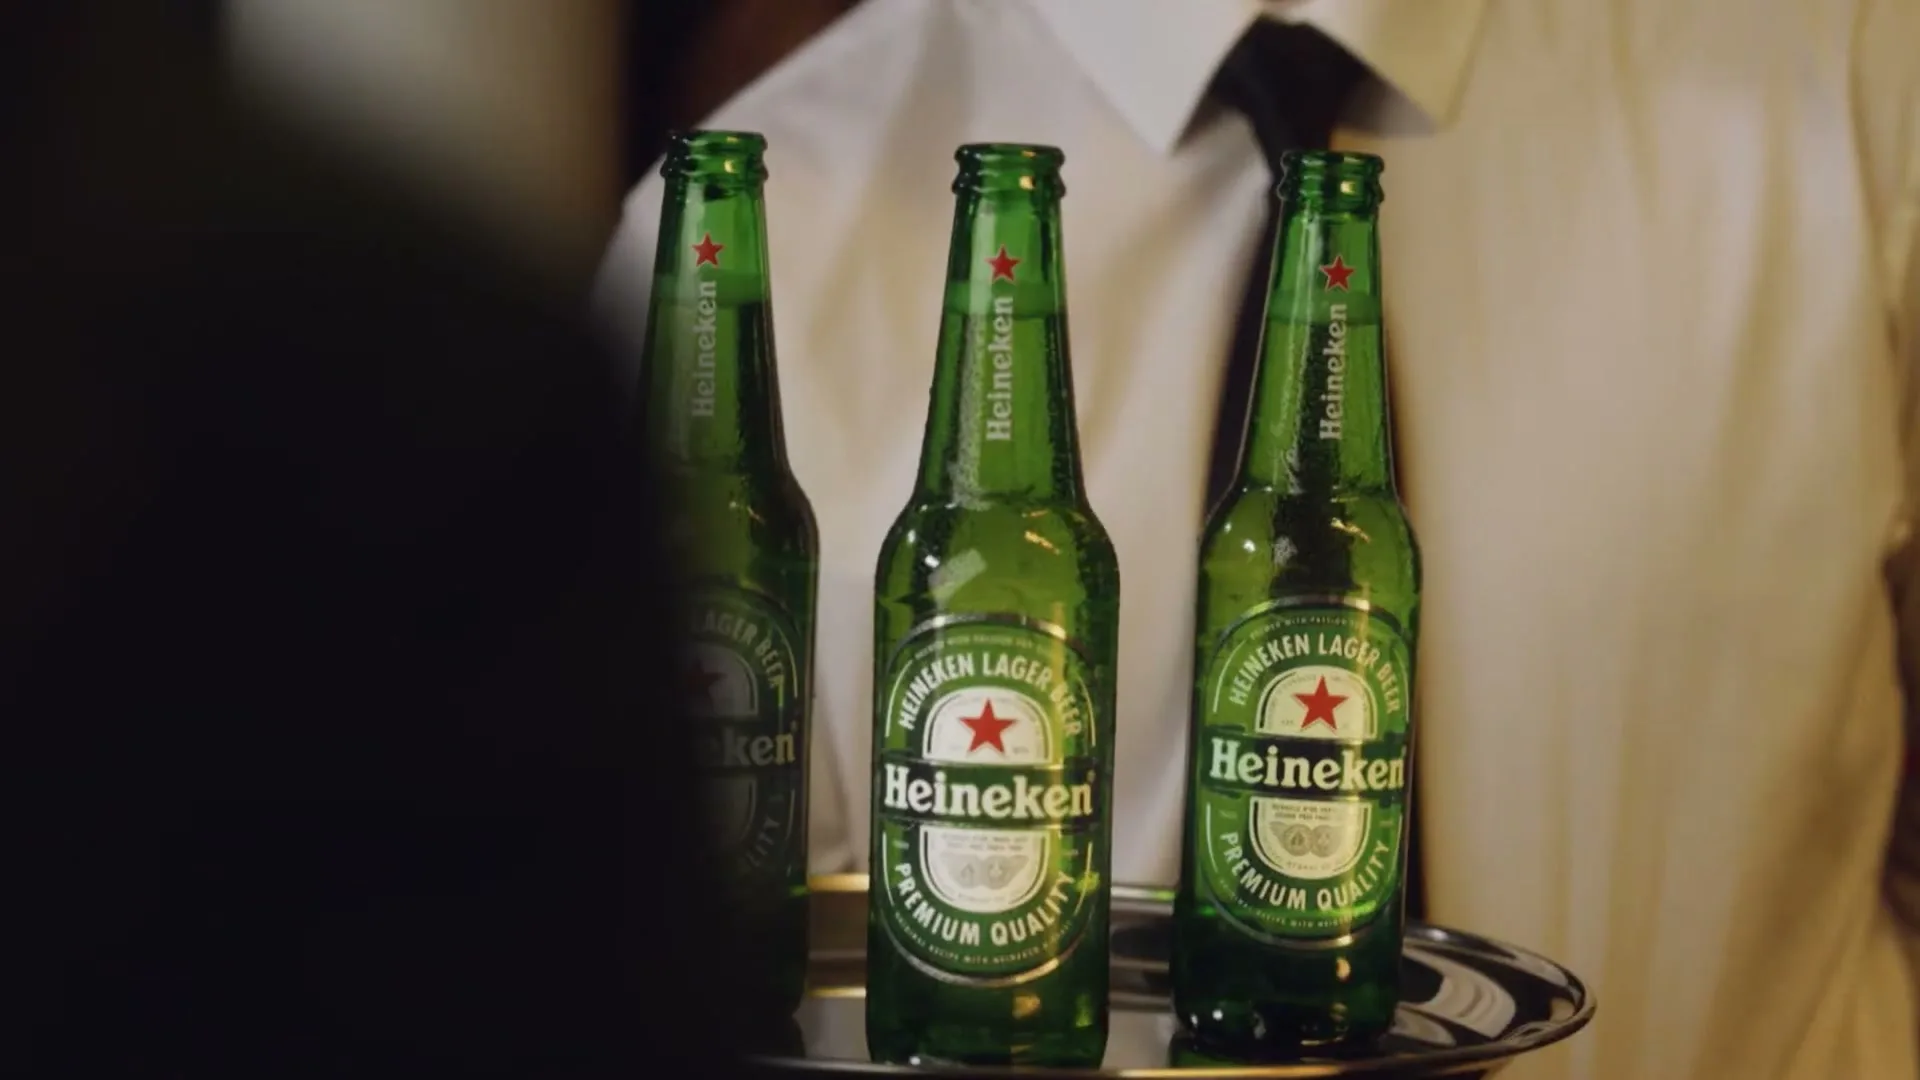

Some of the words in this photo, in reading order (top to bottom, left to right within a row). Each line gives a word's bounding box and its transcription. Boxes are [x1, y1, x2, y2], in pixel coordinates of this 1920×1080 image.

[692, 280, 716, 416] Heineken
[986, 296, 1013, 440] Heineken
[1319, 303, 1347, 440] Heineken
[898, 652, 974, 731] HEINEKEN
[983, 652, 1054, 690] LAGER
[1050, 683, 1082, 737] BEER
[1229, 633, 1311, 706] HEINEKEN
[1318, 633, 1379, 669] LAGER
[1377, 662, 1400, 714] BEER
[884, 763, 1093, 819] Heineken
[1209, 737, 1406, 791] Heineken
[893, 862, 980, 946] PREMIUM
[991, 871, 1074, 946] QUALITY
[1220, 833, 1306, 911] PREMIUM
[1317, 840, 1390, 911] QUALITY
